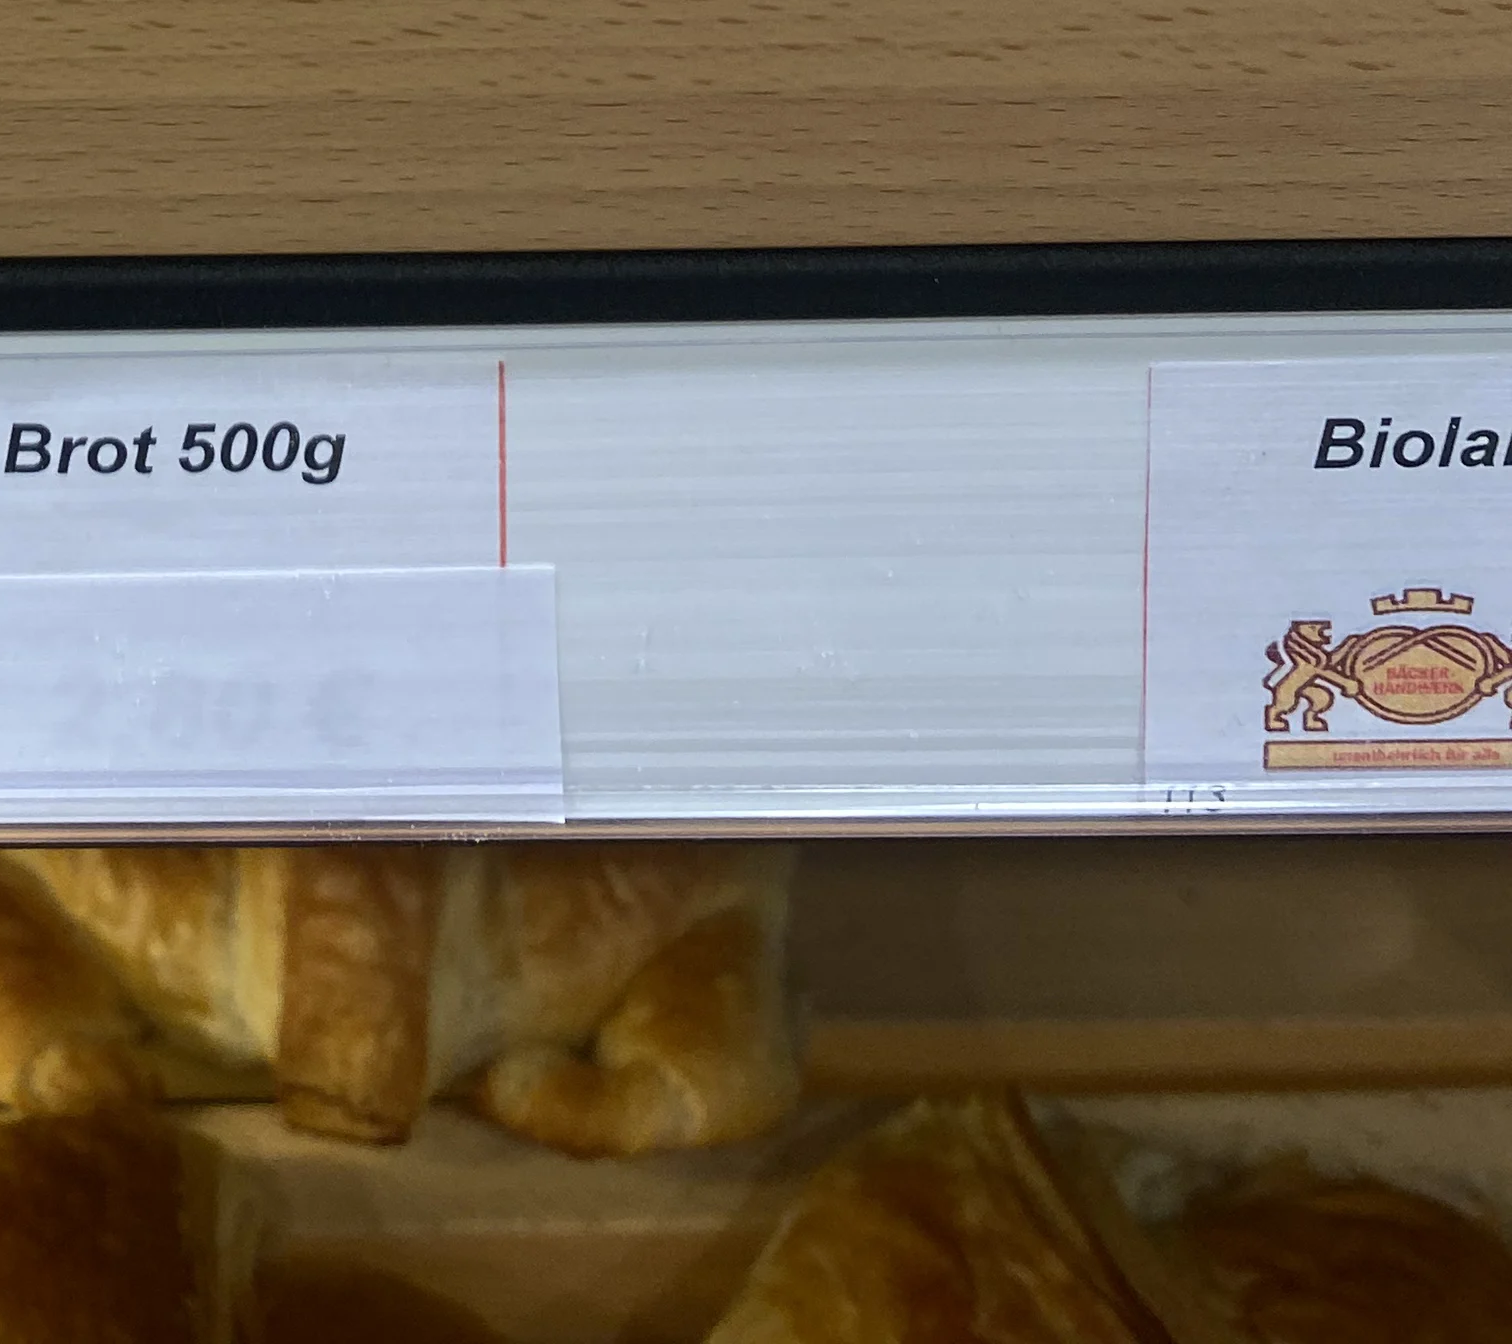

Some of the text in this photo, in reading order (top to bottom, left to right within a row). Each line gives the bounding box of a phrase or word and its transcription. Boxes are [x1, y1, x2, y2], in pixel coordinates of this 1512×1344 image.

[4, 423, 157, 475] Brot
[178, 422, 346, 485] 500g
[1313, 417, 1512, 469] Biola
